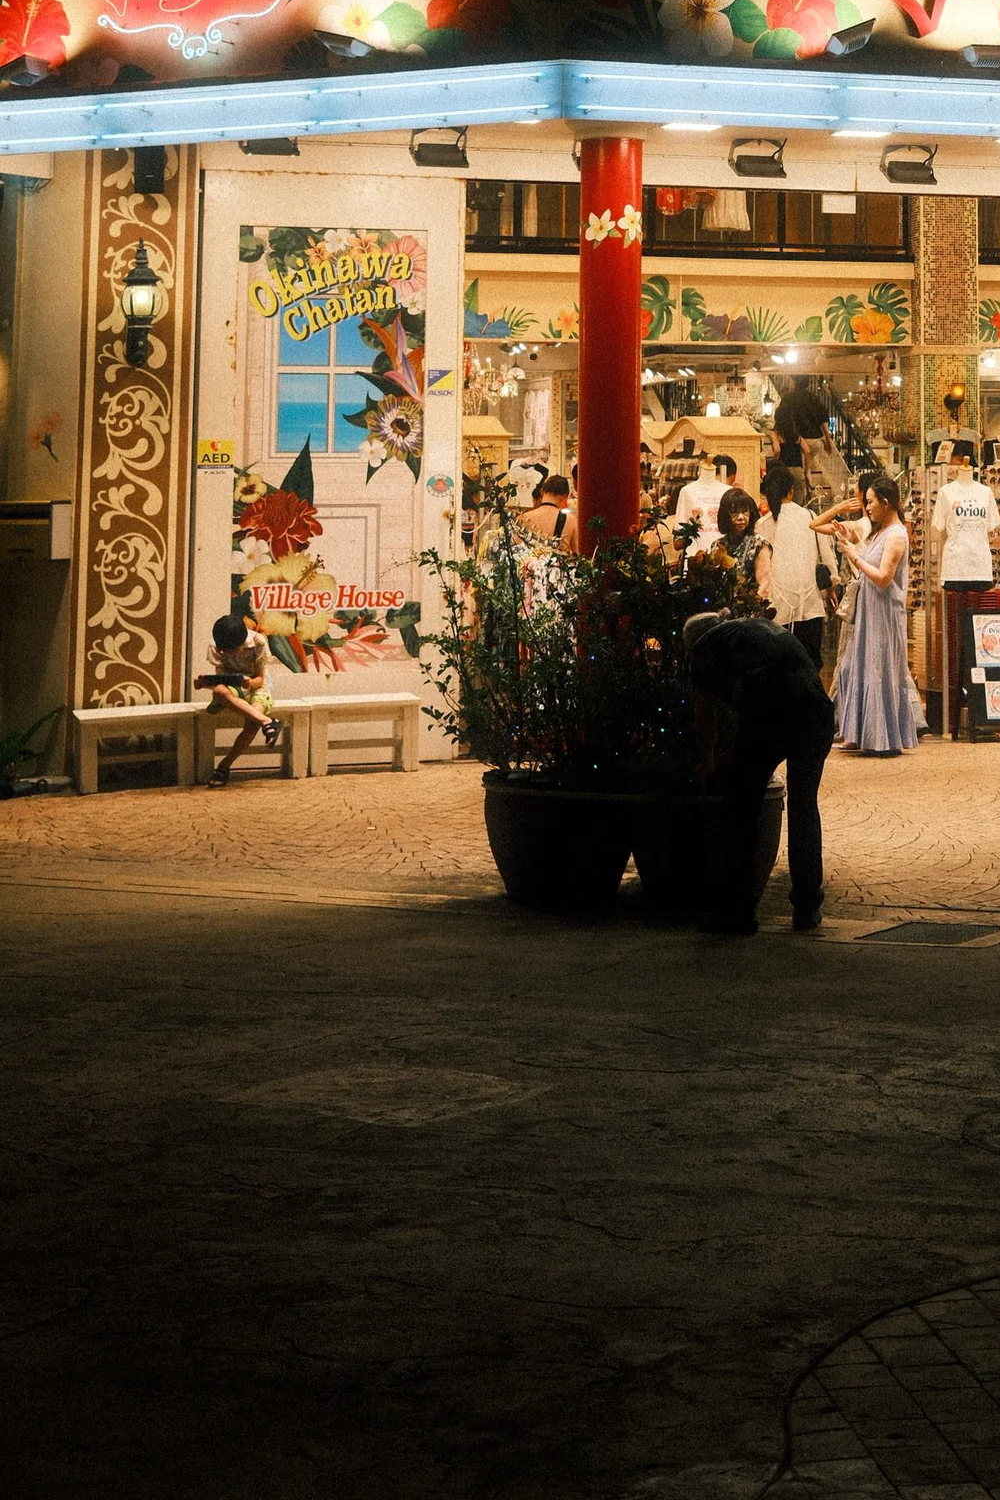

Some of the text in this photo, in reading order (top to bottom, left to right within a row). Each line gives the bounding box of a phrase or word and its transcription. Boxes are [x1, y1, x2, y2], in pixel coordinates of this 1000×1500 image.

[249, 252, 414, 318] Okinawa
[283, 286, 398, 341] Chatan
[201, 453, 231, 464] AED
[252, 583, 405, 616] Village House
